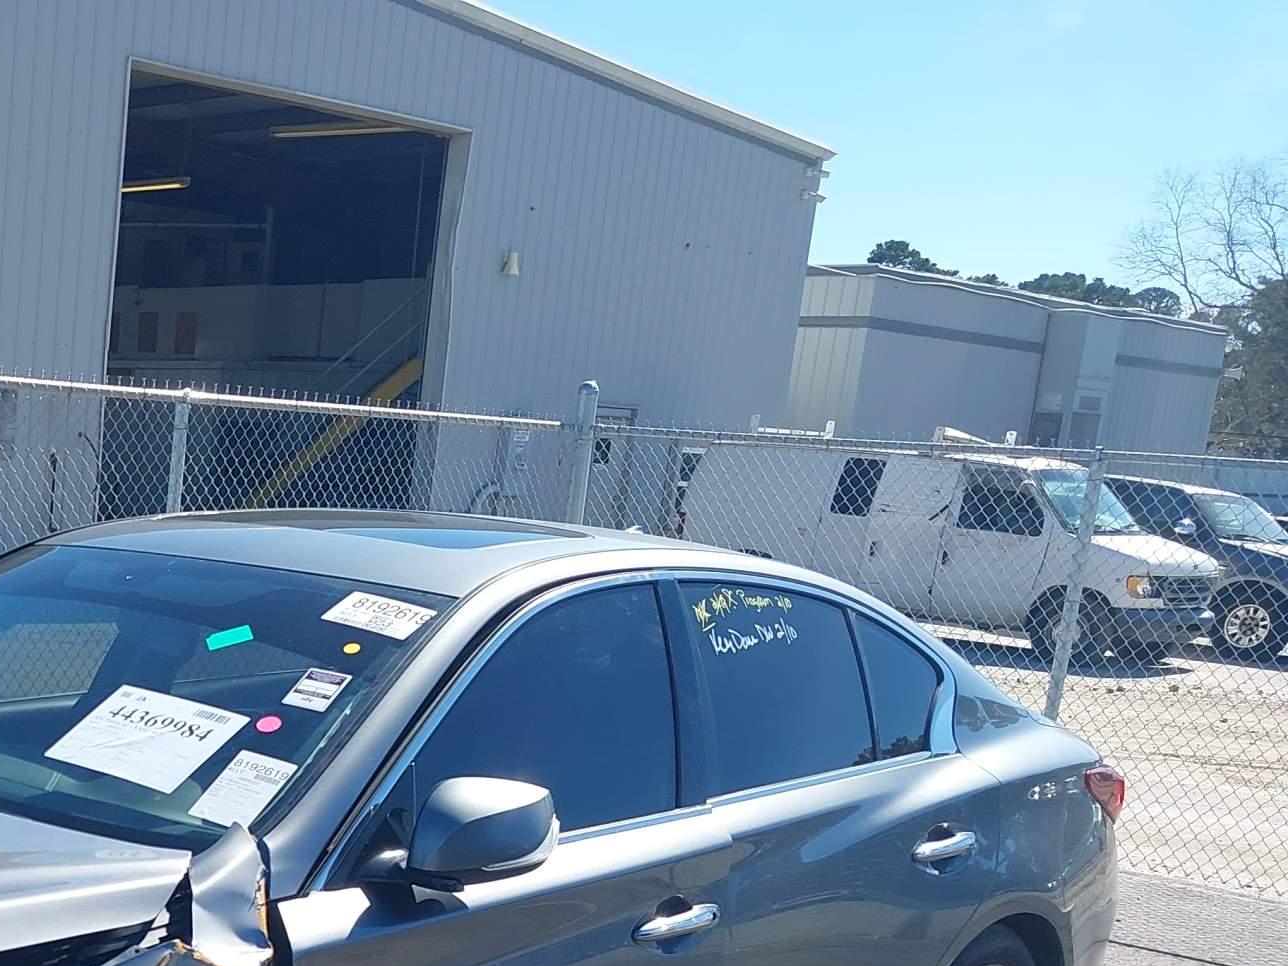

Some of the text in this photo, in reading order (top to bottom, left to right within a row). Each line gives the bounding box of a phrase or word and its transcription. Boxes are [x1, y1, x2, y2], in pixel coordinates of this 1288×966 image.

[352, 597, 433, 625] 8192619
[774, 617, 798, 646] 2/10
[108, 705, 215, 742] 44369984
[233, 758, 290, 781] 8192619
